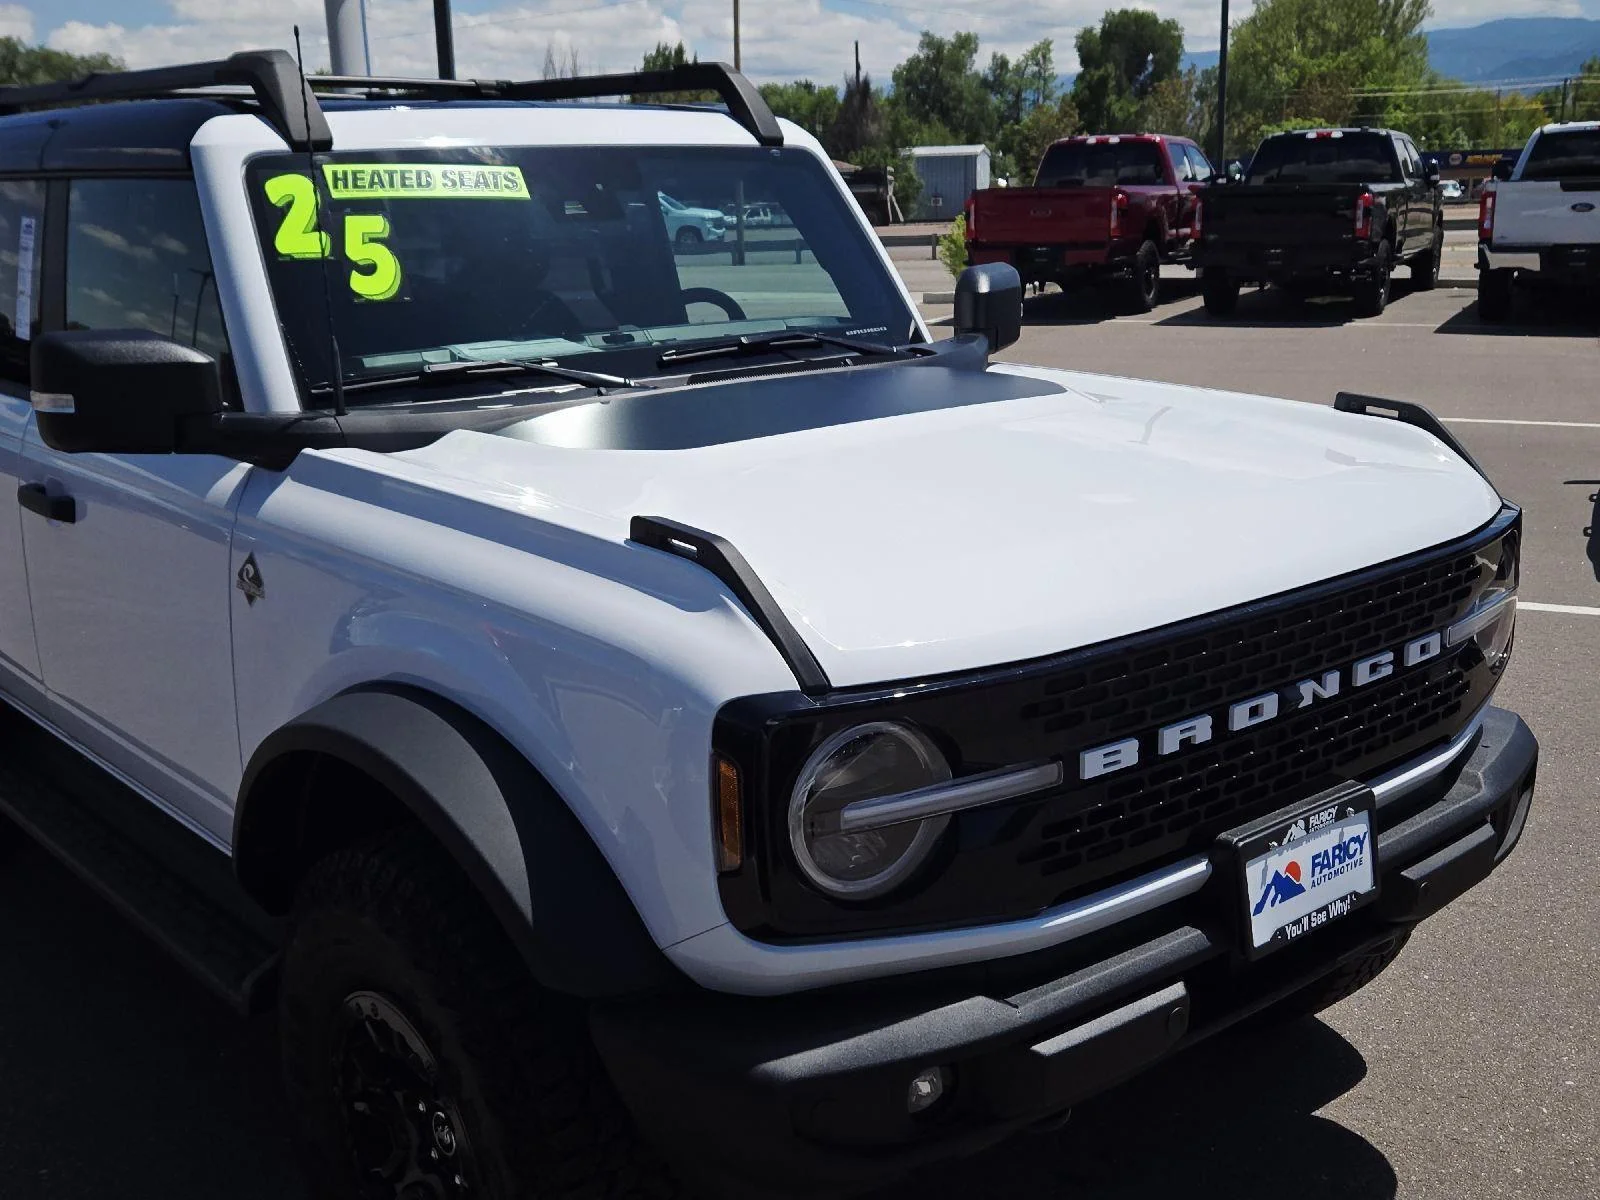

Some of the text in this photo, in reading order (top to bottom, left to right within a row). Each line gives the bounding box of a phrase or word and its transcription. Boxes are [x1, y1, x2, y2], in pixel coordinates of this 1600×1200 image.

[331, 169, 522, 192] HEATED SEATS
[1079, 632, 1441, 780] BRONCO
[1309, 806, 1339, 829] FARICY
[1310, 856, 1364, 890] AUTOMOTIVE
[1311, 831, 1368, 878] FARICY
[1285, 898, 1351, 940] You'll See Why!
